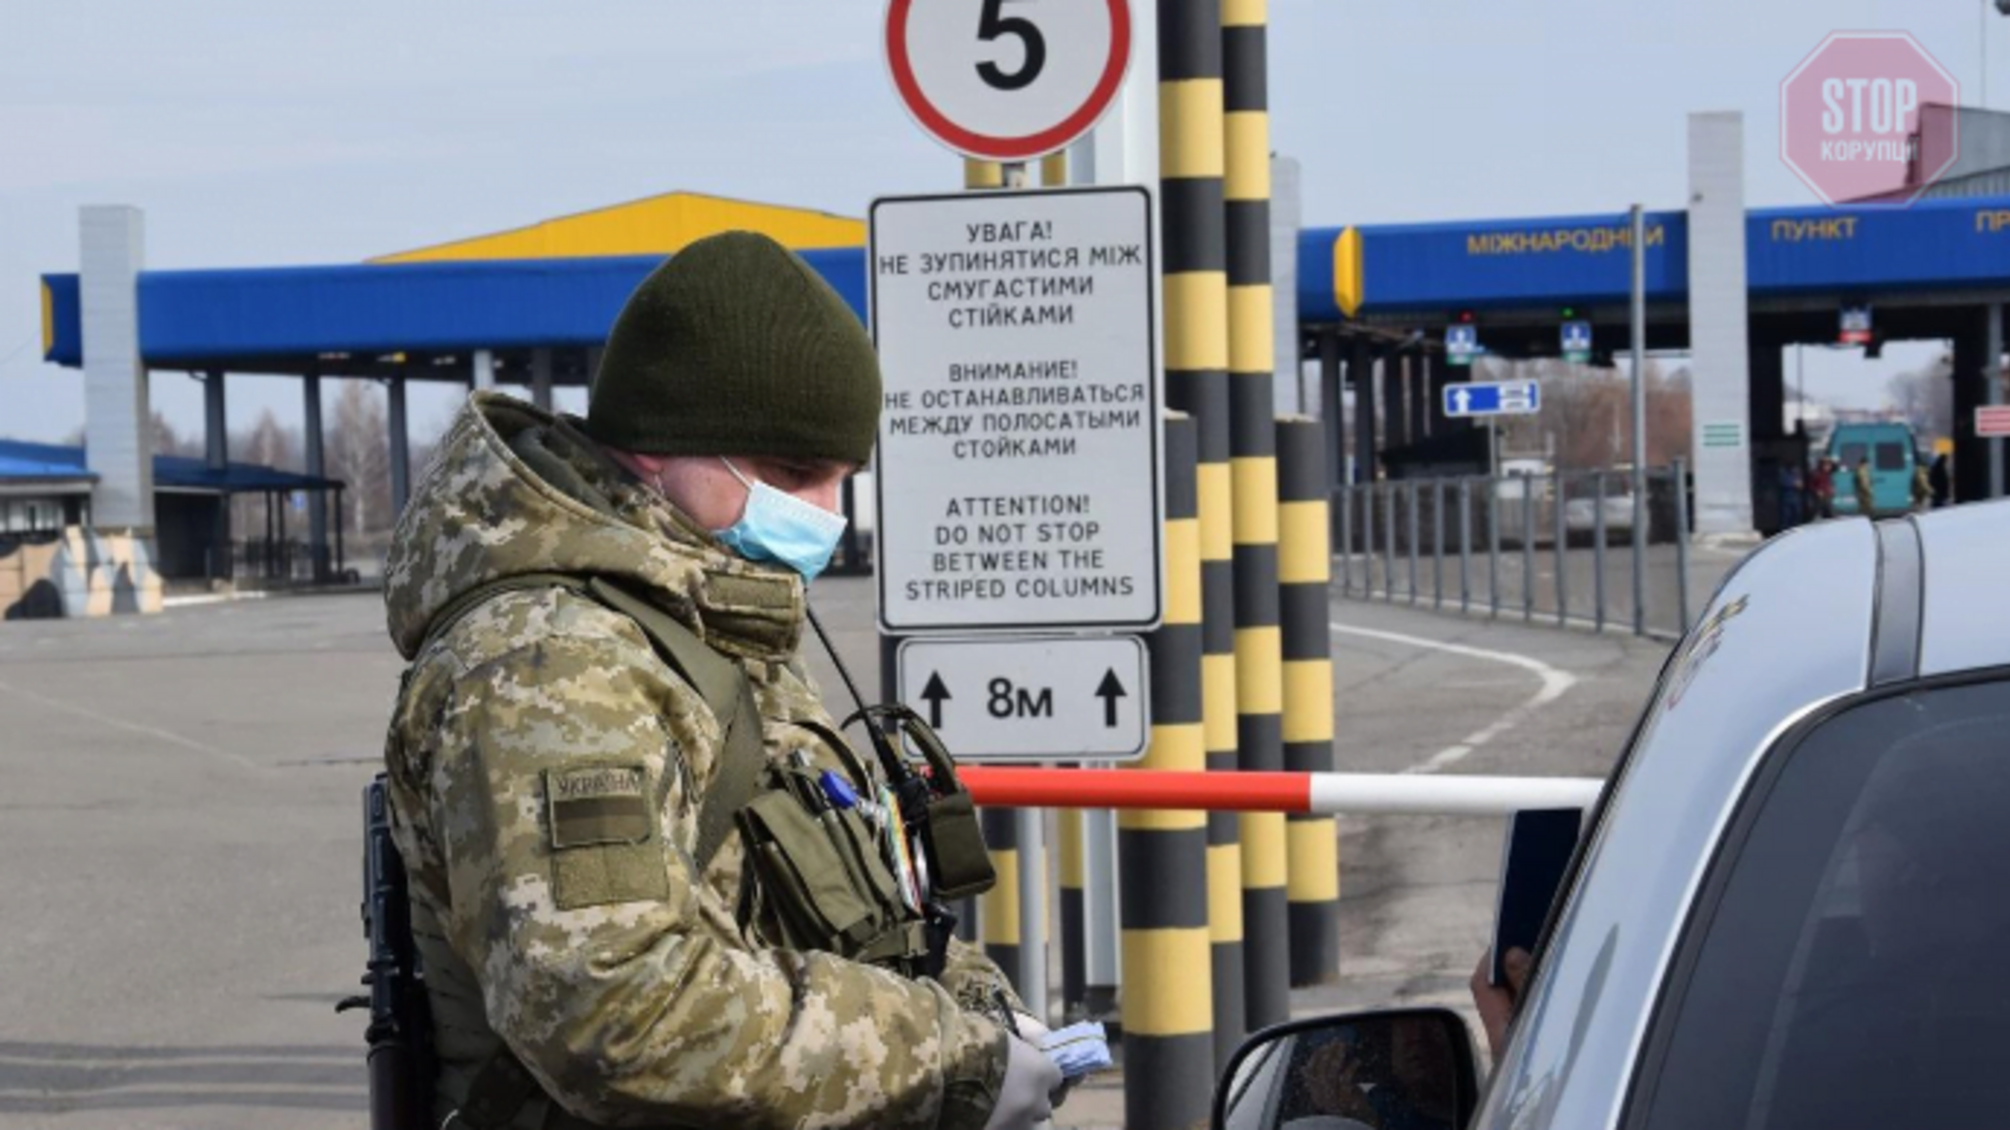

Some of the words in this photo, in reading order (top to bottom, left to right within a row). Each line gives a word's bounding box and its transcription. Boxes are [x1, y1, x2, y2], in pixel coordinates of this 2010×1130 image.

[975, 0, 1046, 90] 5
[966, 221, 1052, 243] УВАГА!
[1467, 224, 1664, 255] МІЖНАРОДНЙ
[1772, 217, 1858, 242] ПУНКТ
[880, 255, 908, 274] НЕ
[920, 247, 1079, 274] ЗУПИНЯТИСЯ
[1089, 245, 1142, 266] МІЖ
[928, 276, 1094, 301] СМУГАСТИМИ
[949, 303, 1073, 328] СТІЙКАМИ
[950, 360, 1077, 383] ВНИМАНИЕ!
[885, 392, 911, 409] НЕ
[922, 383, 1144, 409] ОСТАНАВЛИВАТЬСЯ
[890, 416, 972, 436] МЕЖДУ
[983, 410, 1139, 432] ПОЛОСАТЫМИ
[953, 437, 1076, 459] СТОЙКАМИ
[946, 495, 1090, 517] ATTENTION!
[936, 526, 968, 546] DO
[978, 524, 1026, 544] NOT
[1037, 521, 1100, 543] STOP
[933, 553, 1048, 572] BETWEEN
[1059, 550, 1104, 569] THE
[906, 579, 1005, 600] STRIPED
[1016, 576, 1134, 598] COLUMNS
